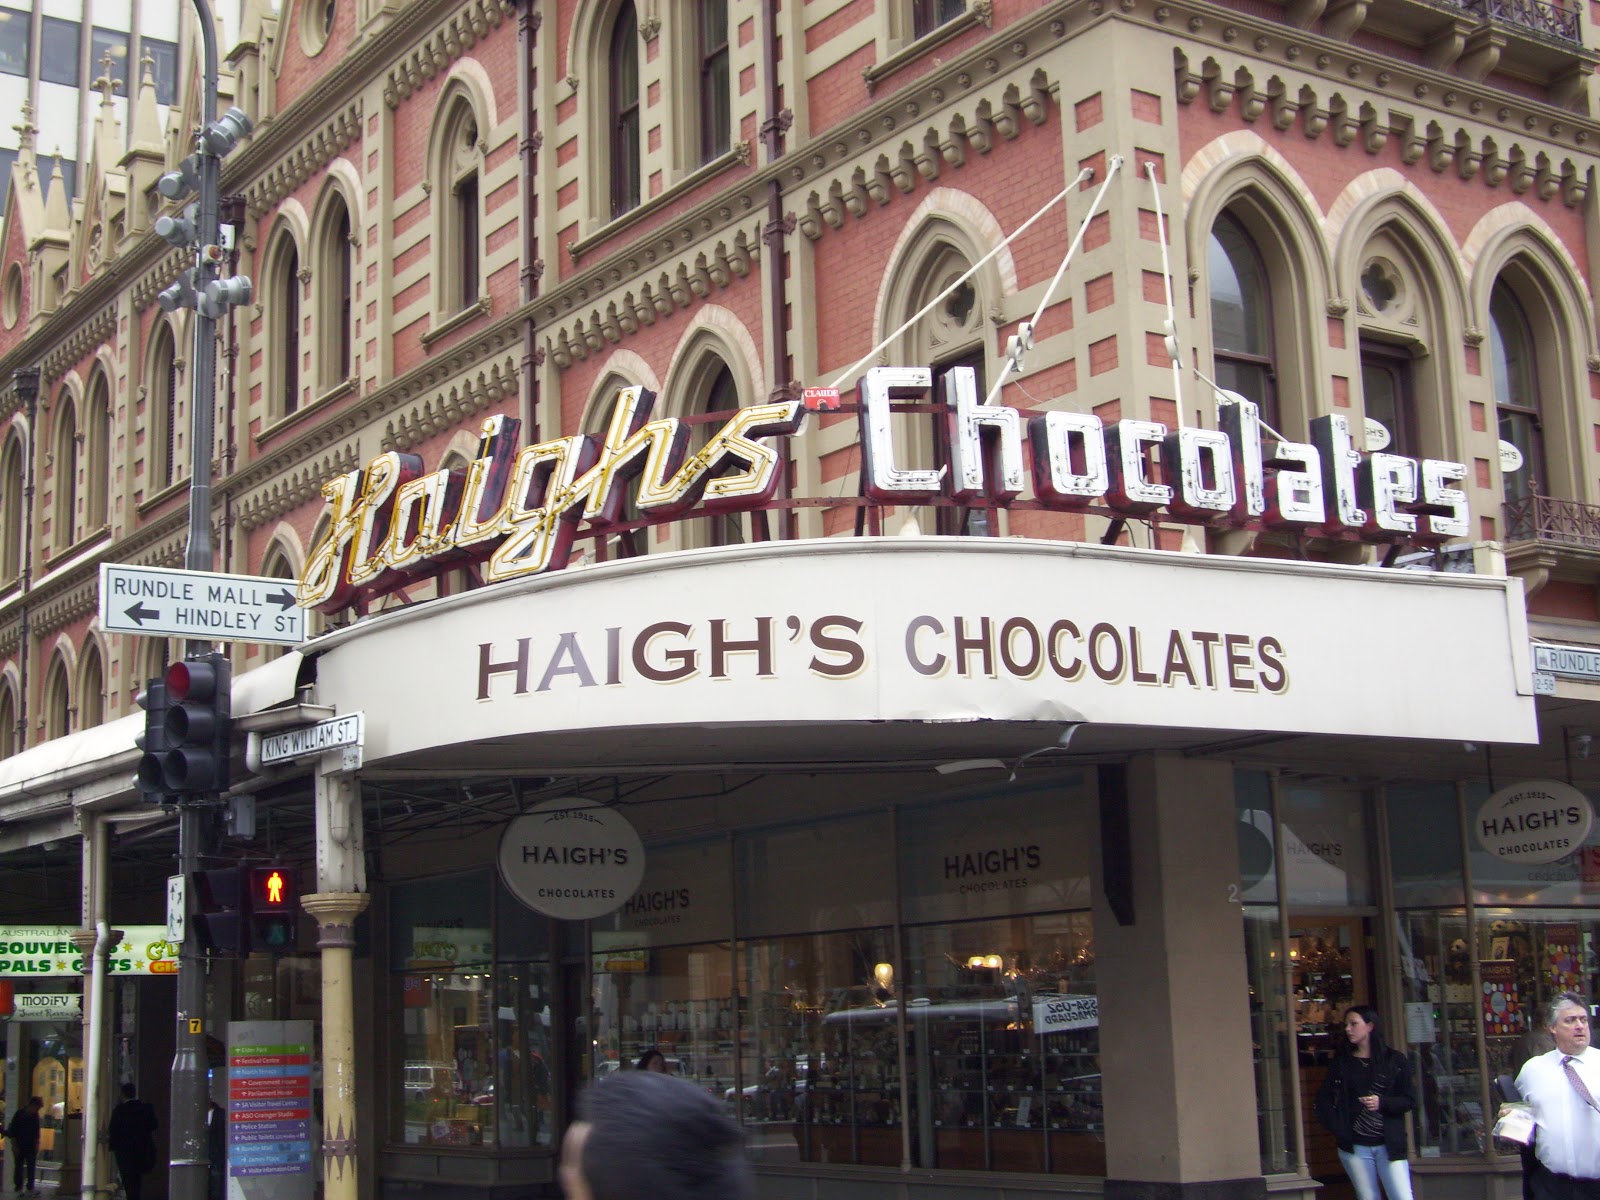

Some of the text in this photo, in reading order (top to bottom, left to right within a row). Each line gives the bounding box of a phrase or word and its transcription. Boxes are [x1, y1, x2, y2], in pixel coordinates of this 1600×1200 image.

[860, 366, 1470, 538] Chocolates
[114, 577, 262, 607] RUNDLE MALL
[176, 607, 297, 634] HINDLEY ST
[475, 614, 1293, 702] HAIGH'S CHOCOLATES
[265, 736, 289, 758] KING
[291, 727, 334, 751] WILLIAM
[1482, 806, 1581, 837] HAIGH'S
[522, 845, 629, 866] HAIGH'S
[1498, 838, 1570, 856] CHOCOLATES
[944, 845, 1041, 880] HAIGH'S
[538, 887, 615, 899] CHOCOLATES
[959, 877, 1028, 894] CHOCOLATES
[1227, 883, 1239, 903] 2
[625, 888, 690, 915] HAIGH'S
[191, 1020, 199, 1032] 7
